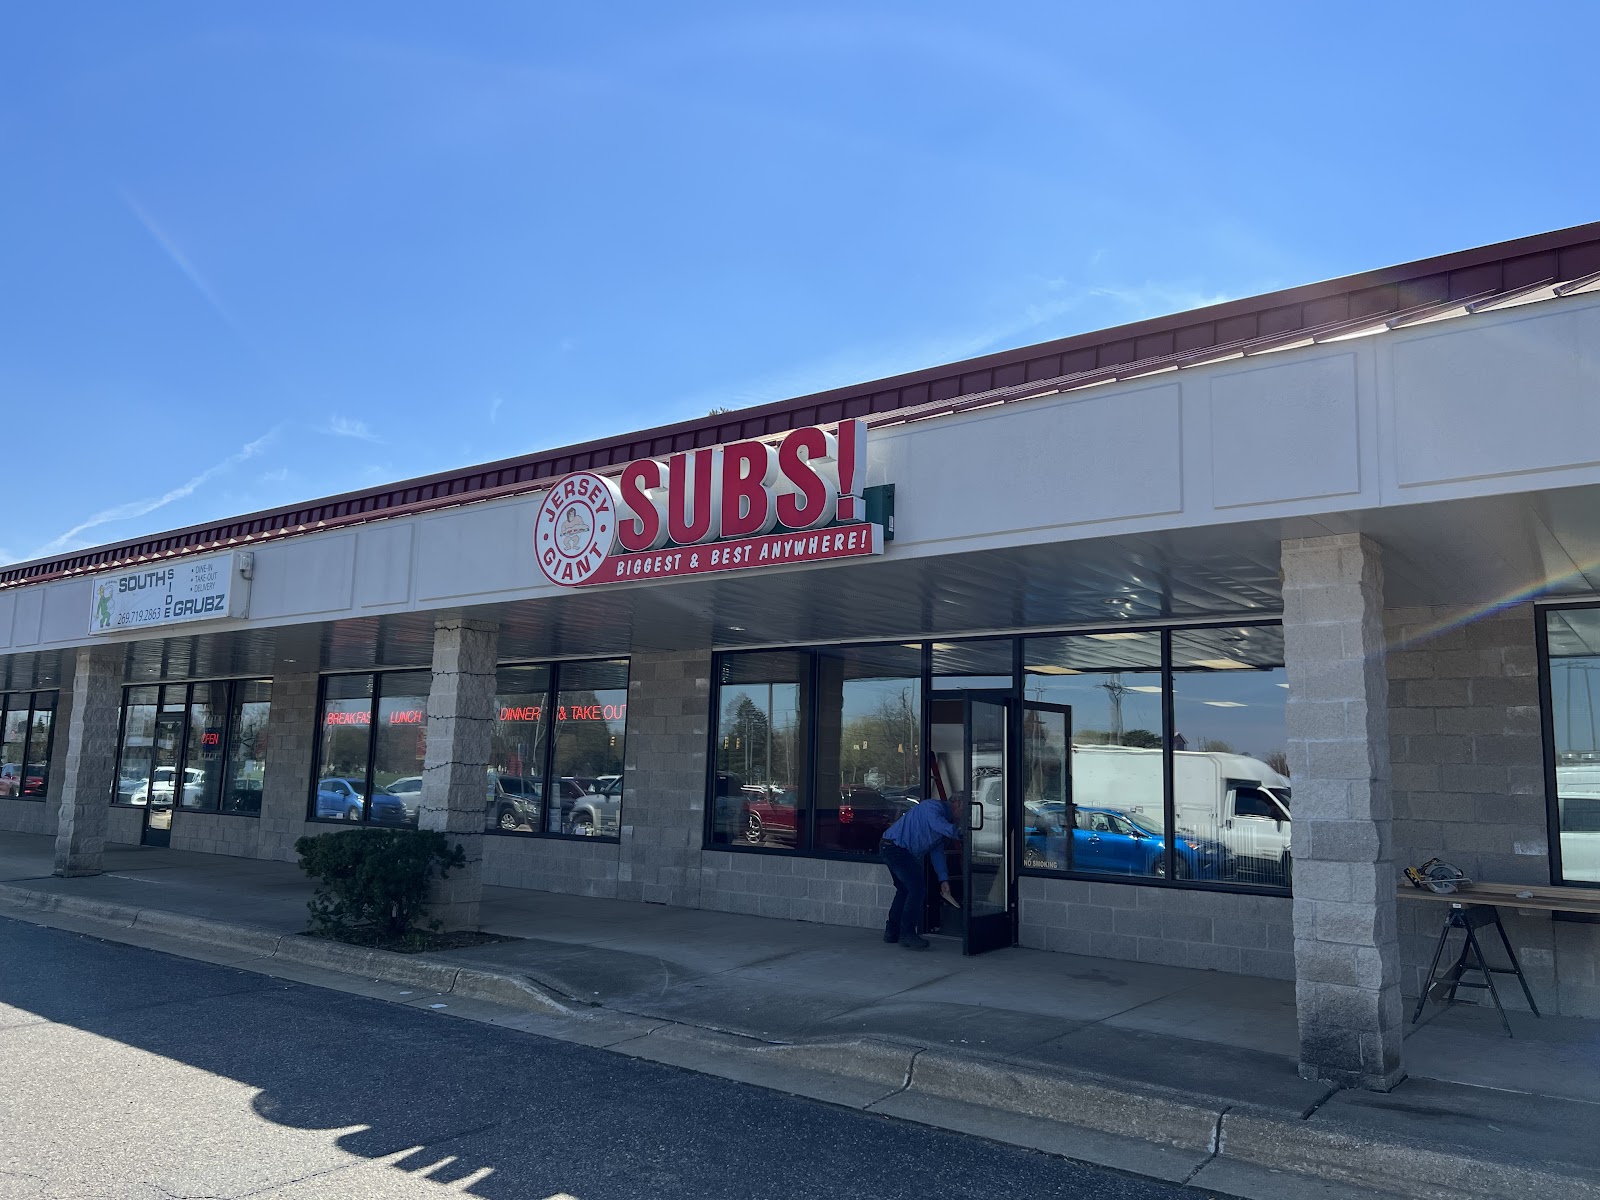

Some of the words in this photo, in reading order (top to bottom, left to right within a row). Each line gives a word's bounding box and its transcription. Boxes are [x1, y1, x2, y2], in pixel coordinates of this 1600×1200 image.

[618, 419, 856, 551] SUBS!
[545, 478, 610, 523] JERSEY
[543, 541, 602, 580] GIANT
[616, 553, 682, 577] BIGGEST
[690, 552, 699, 569] &
[710, 544, 752, 566] BEST
[759, 529, 867, 560] ANYWHERE!
[195, 563, 213, 574] DINE-IN
[118, 570, 166, 593] SOUTH
[195, 571, 218, 583] TAKE-OUT
[194, 582, 216, 593] DELIVERY
[173, 593, 225, 617] GRUBZ
[117, 607, 161, 625] 269.719.2863
[327, 711, 371, 725] BREAKFAS
[389, 709, 423, 724] LUNCH
[500, 706, 540, 721] DINNER
[558, 705, 568, 720] &
[570, 704, 601, 720] TAKE
[201, 733, 219, 745] OPEN
[1023, 859, 1032, 867] NO
[1032, 860, 1058, 869] SMOKING
